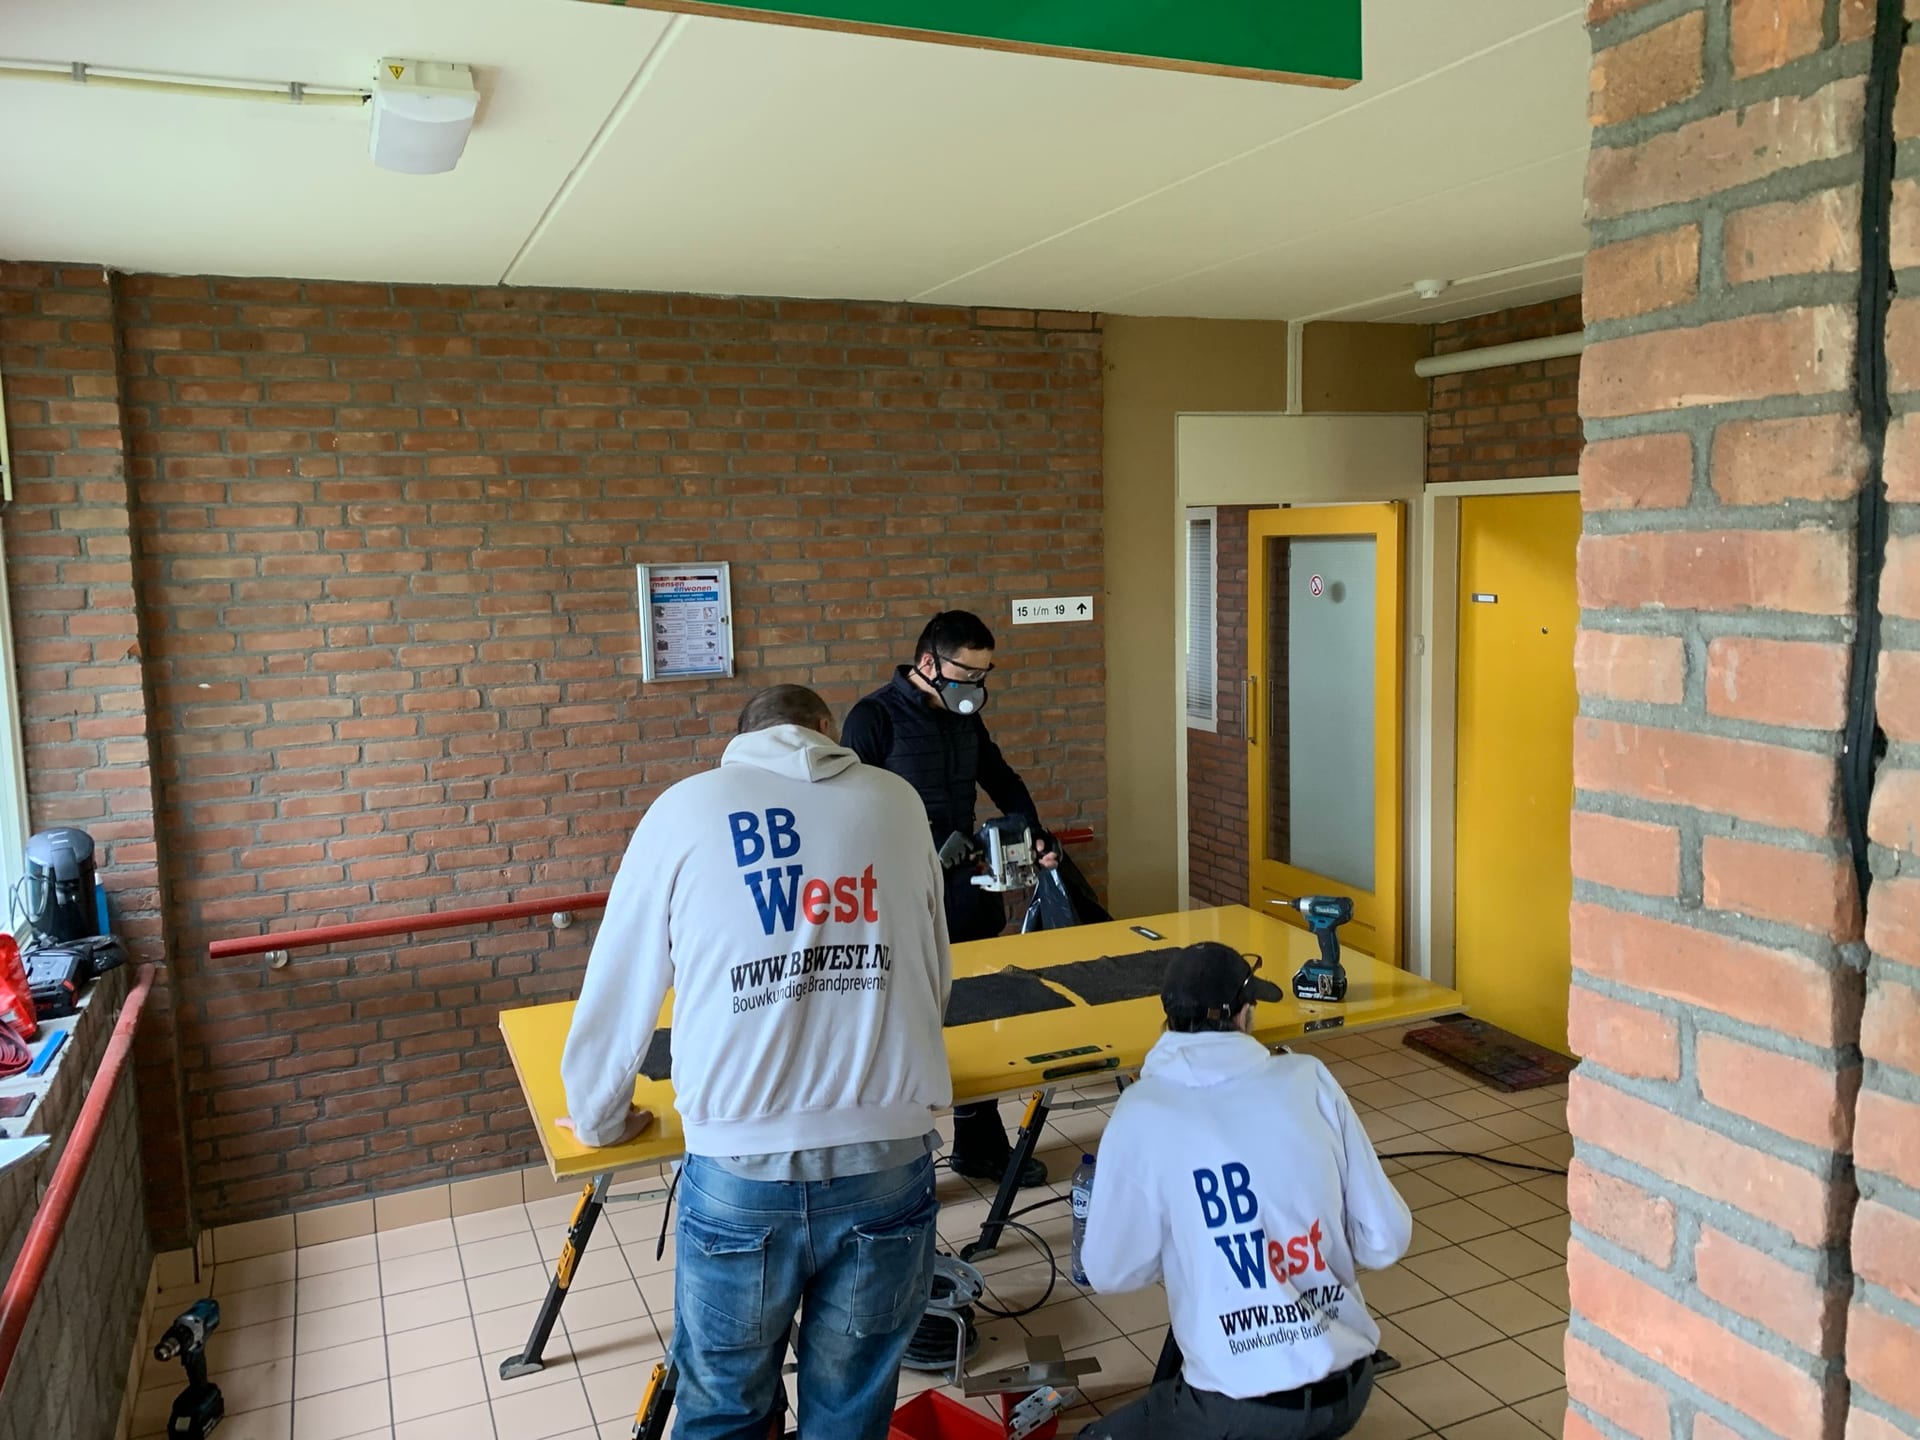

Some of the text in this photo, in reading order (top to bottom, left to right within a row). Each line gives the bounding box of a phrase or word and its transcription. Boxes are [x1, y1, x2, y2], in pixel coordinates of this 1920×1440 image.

[1017, 606, 1028, 617] 15
[1054, 604, 1065, 615] 19
[728, 807, 801, 868] BB
[744, 863, 879, 936] West
[730, 943, 892, 993] WWW.BBWEST.NL
[733, 979, 807, 1014] Bouwkundige
[1192, 1161, 1259, 1229] BB
[1214, 1217, 1326, 1290] West
[1228, 1327, 1300, 1356] Bouwkundige
